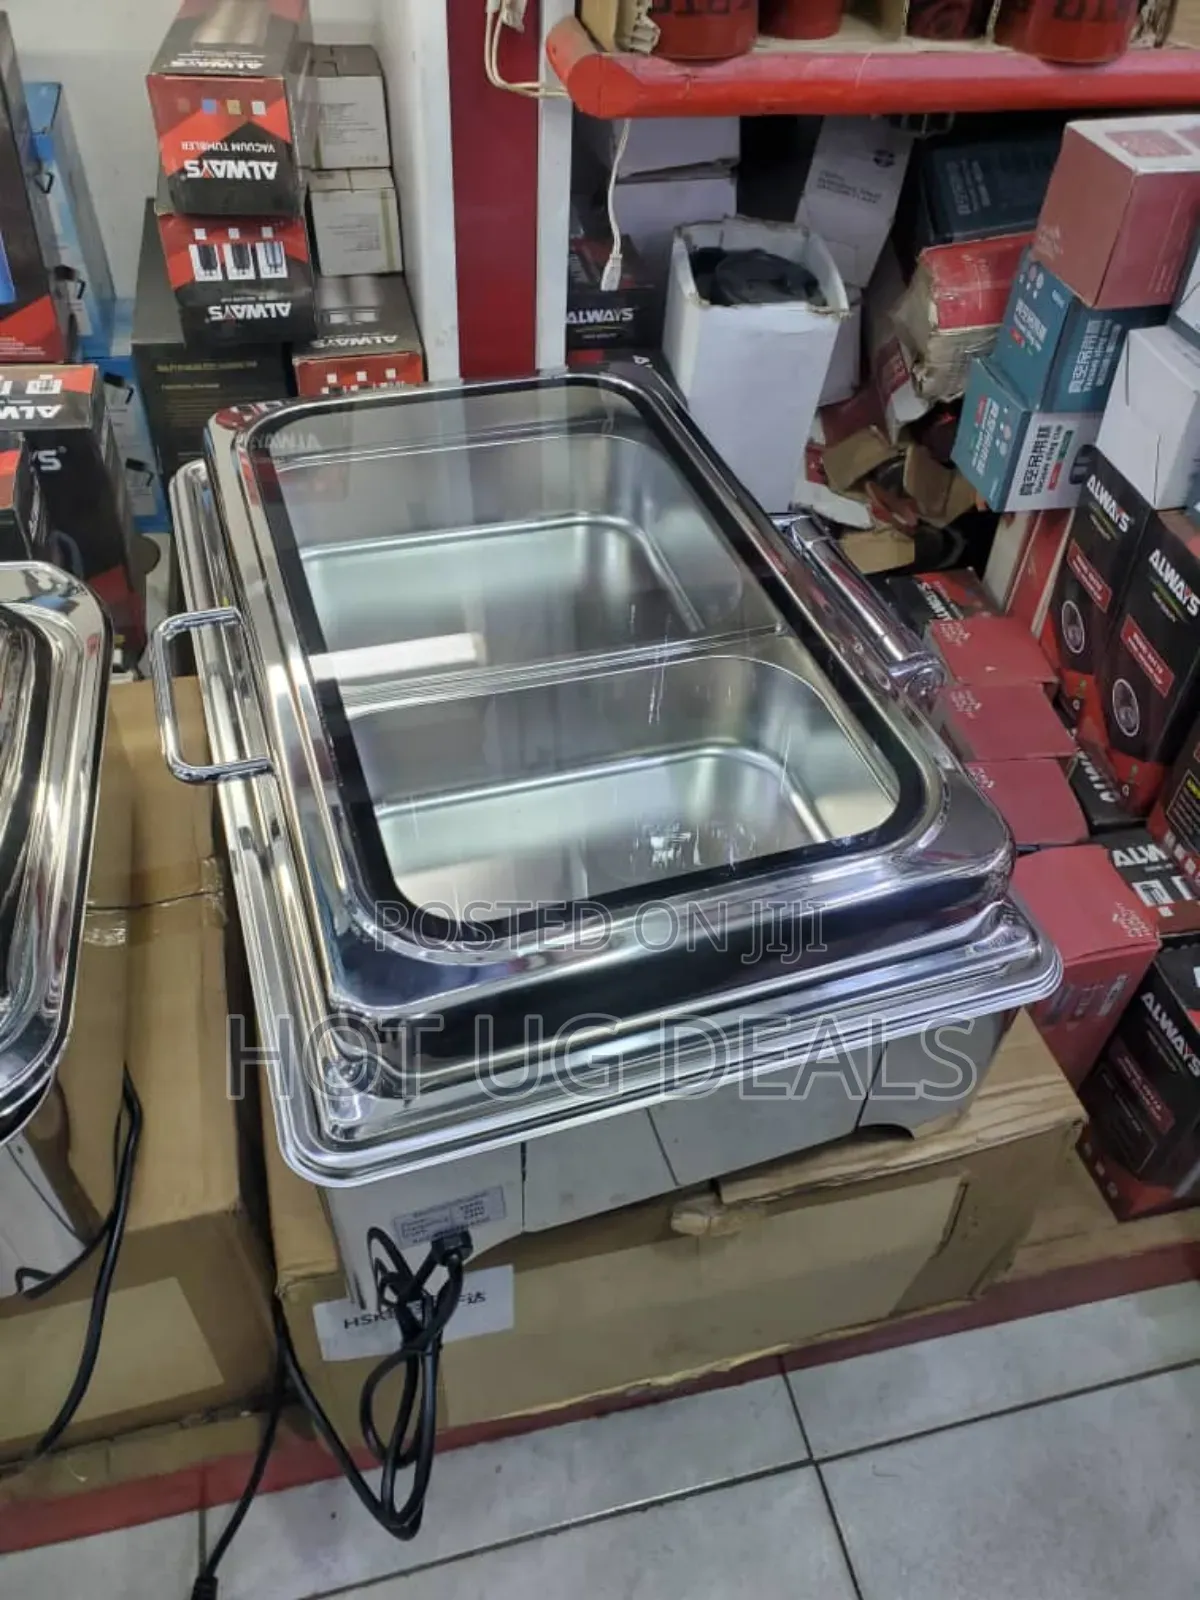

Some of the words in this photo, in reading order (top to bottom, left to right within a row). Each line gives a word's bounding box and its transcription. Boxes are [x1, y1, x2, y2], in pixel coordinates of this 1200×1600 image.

[181, 141, 229, 152] TUMBLER
[231, 142, 275, 153] VACUUM
[183, 159, 278, 180] ALWAYS
[207, 302, 292, 321] ALWAYS
[564, 307, 634, 324] ALWAYS
[309, 333, 397, 349] ALWAYS
[1087, 474, 1131, 533] ALWAYS
[1149, 548, 1200, 617] ALWAYS
[1141, 991, 1200, 1077] ALWAYS
